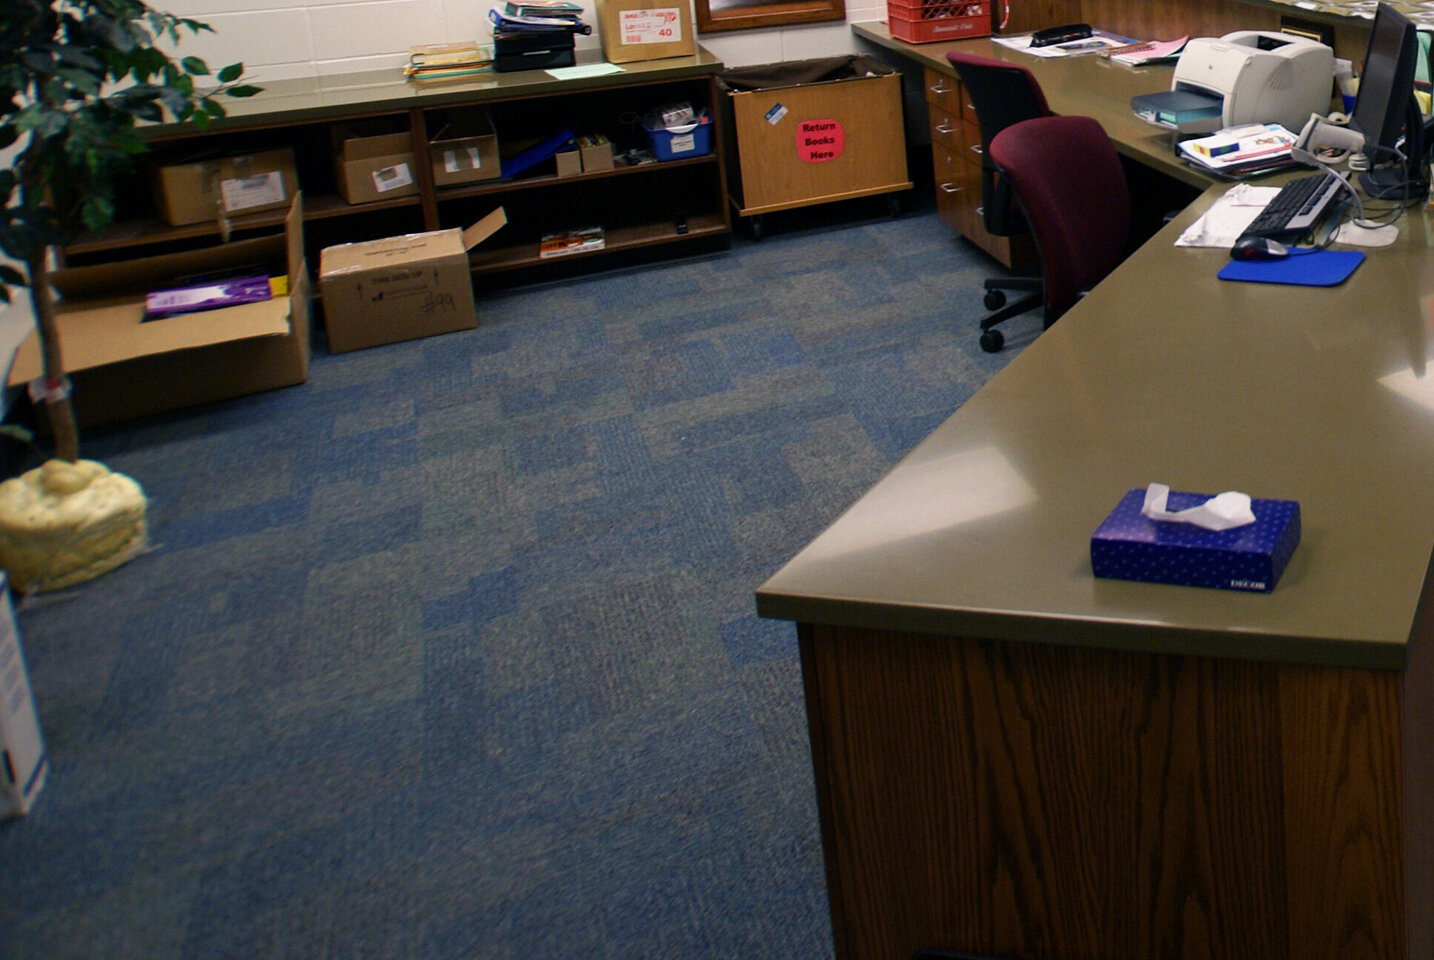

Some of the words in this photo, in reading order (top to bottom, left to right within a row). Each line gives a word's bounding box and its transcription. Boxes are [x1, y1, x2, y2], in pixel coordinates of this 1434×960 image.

[659, 28, 672, 37] 40
[803, 123, 836, 132] Return
[805, 137, 835, 146] Books
[810, 151, 834, 159] Here
